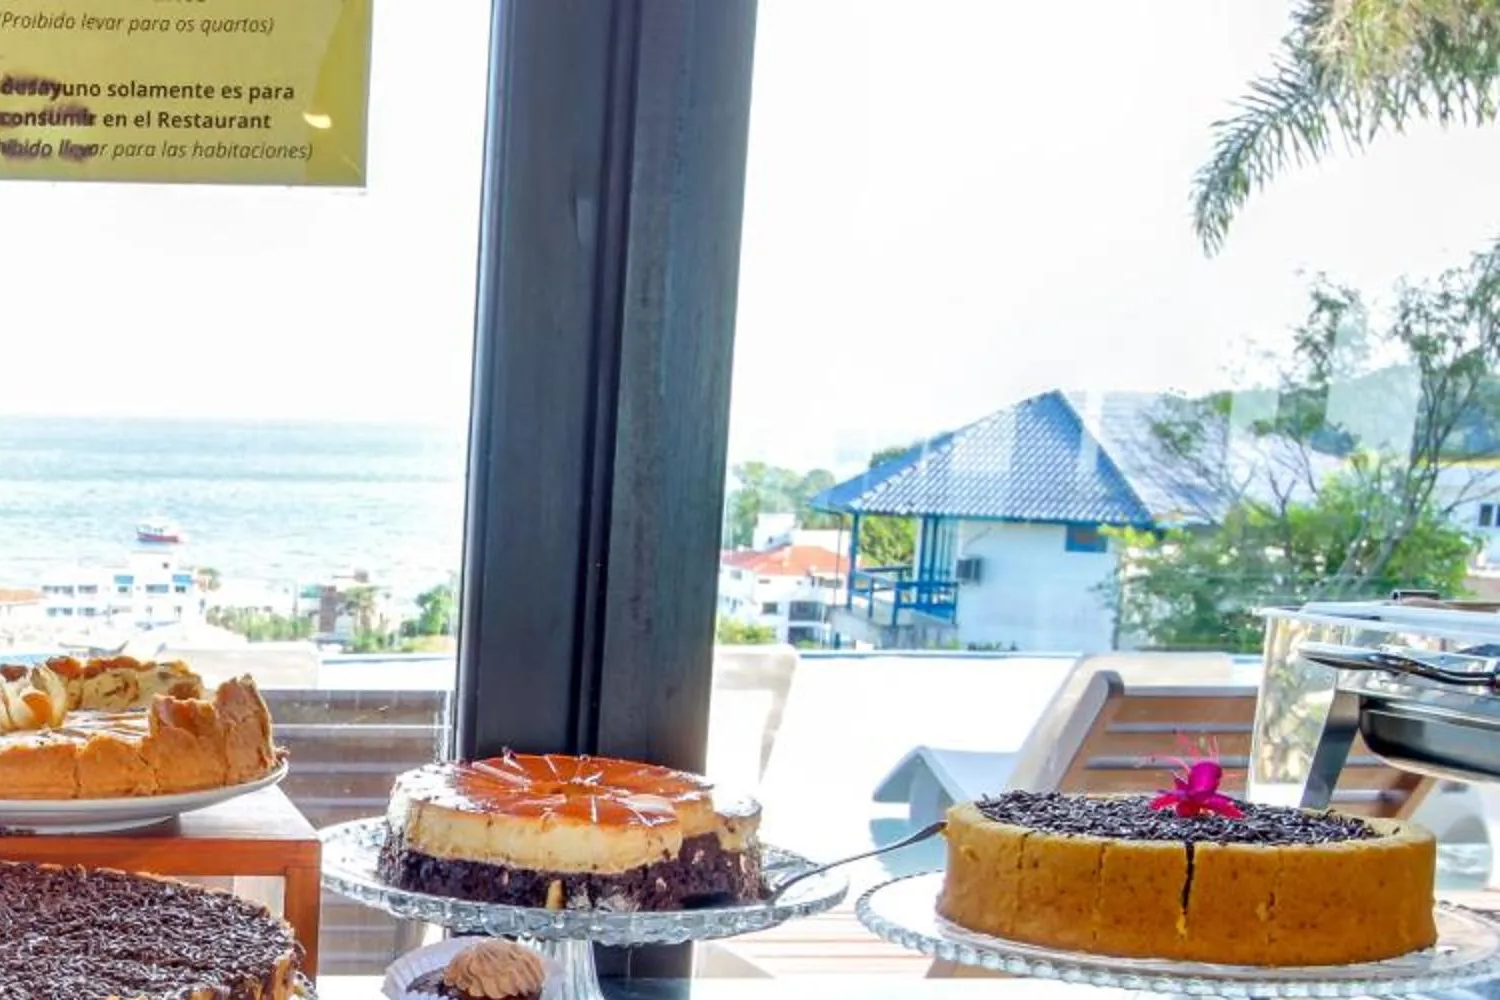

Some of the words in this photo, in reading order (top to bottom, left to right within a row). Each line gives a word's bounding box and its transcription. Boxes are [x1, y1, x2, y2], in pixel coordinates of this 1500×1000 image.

[81, 13, 123, 30] levar
[127, 17, 171, 36] para
[175, 18, 195, 33] os
[201, 17, 275, 37] quartos)
[107, 80, 215, 99] solamente
[221, 84, 243, 99] es
[249, 84, 295, 103] para
[103, 112, 127, 127] en
[133, 110, 151, 128] el
[157, 111, 271, 129] Restaurant
[112, 142, 156, 160] para
[161, 140, 186, 158] las
[191, 140, 314, 163] habitaciones)
